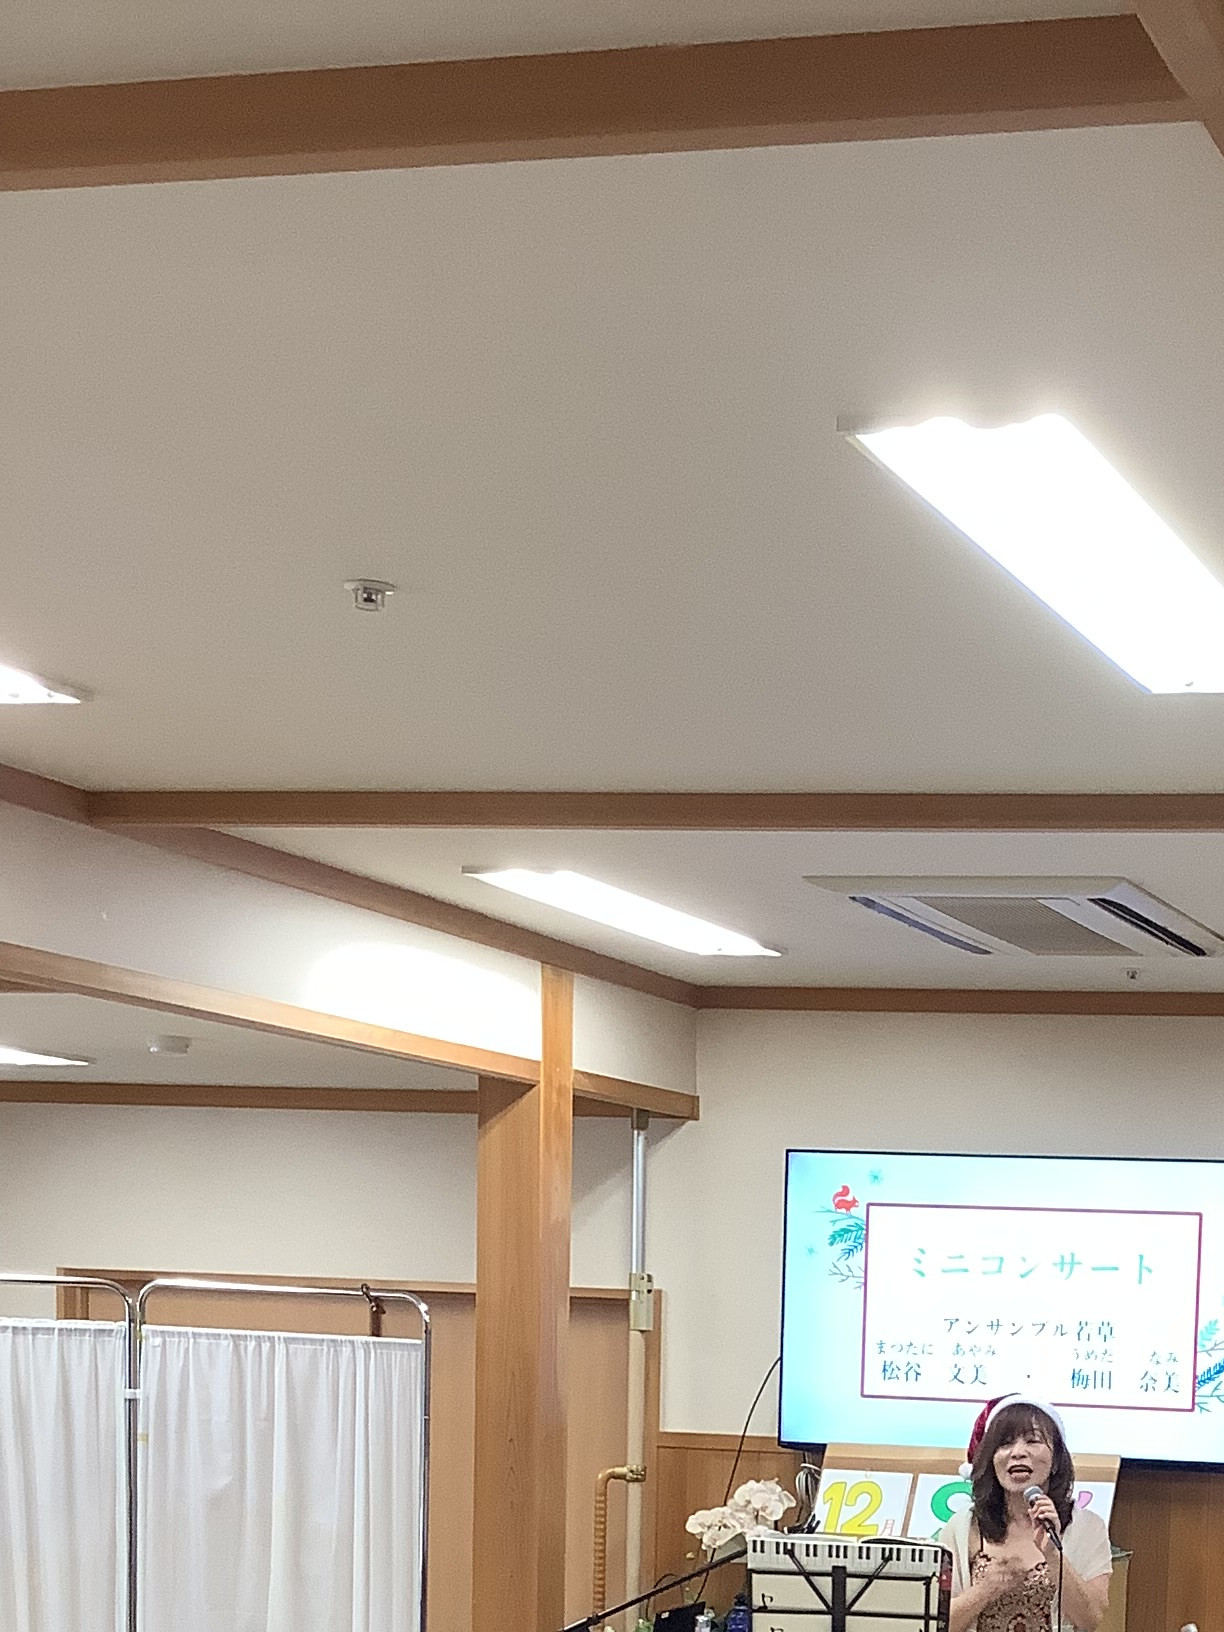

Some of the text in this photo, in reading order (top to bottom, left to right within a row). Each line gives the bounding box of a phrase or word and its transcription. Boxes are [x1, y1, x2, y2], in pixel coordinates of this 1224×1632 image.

[912, 1247, 1153, 1285] ミニコンサート
[876, 1340, 934, 1355] まつたに
[882, 1360, 922, 1382] 松谷
